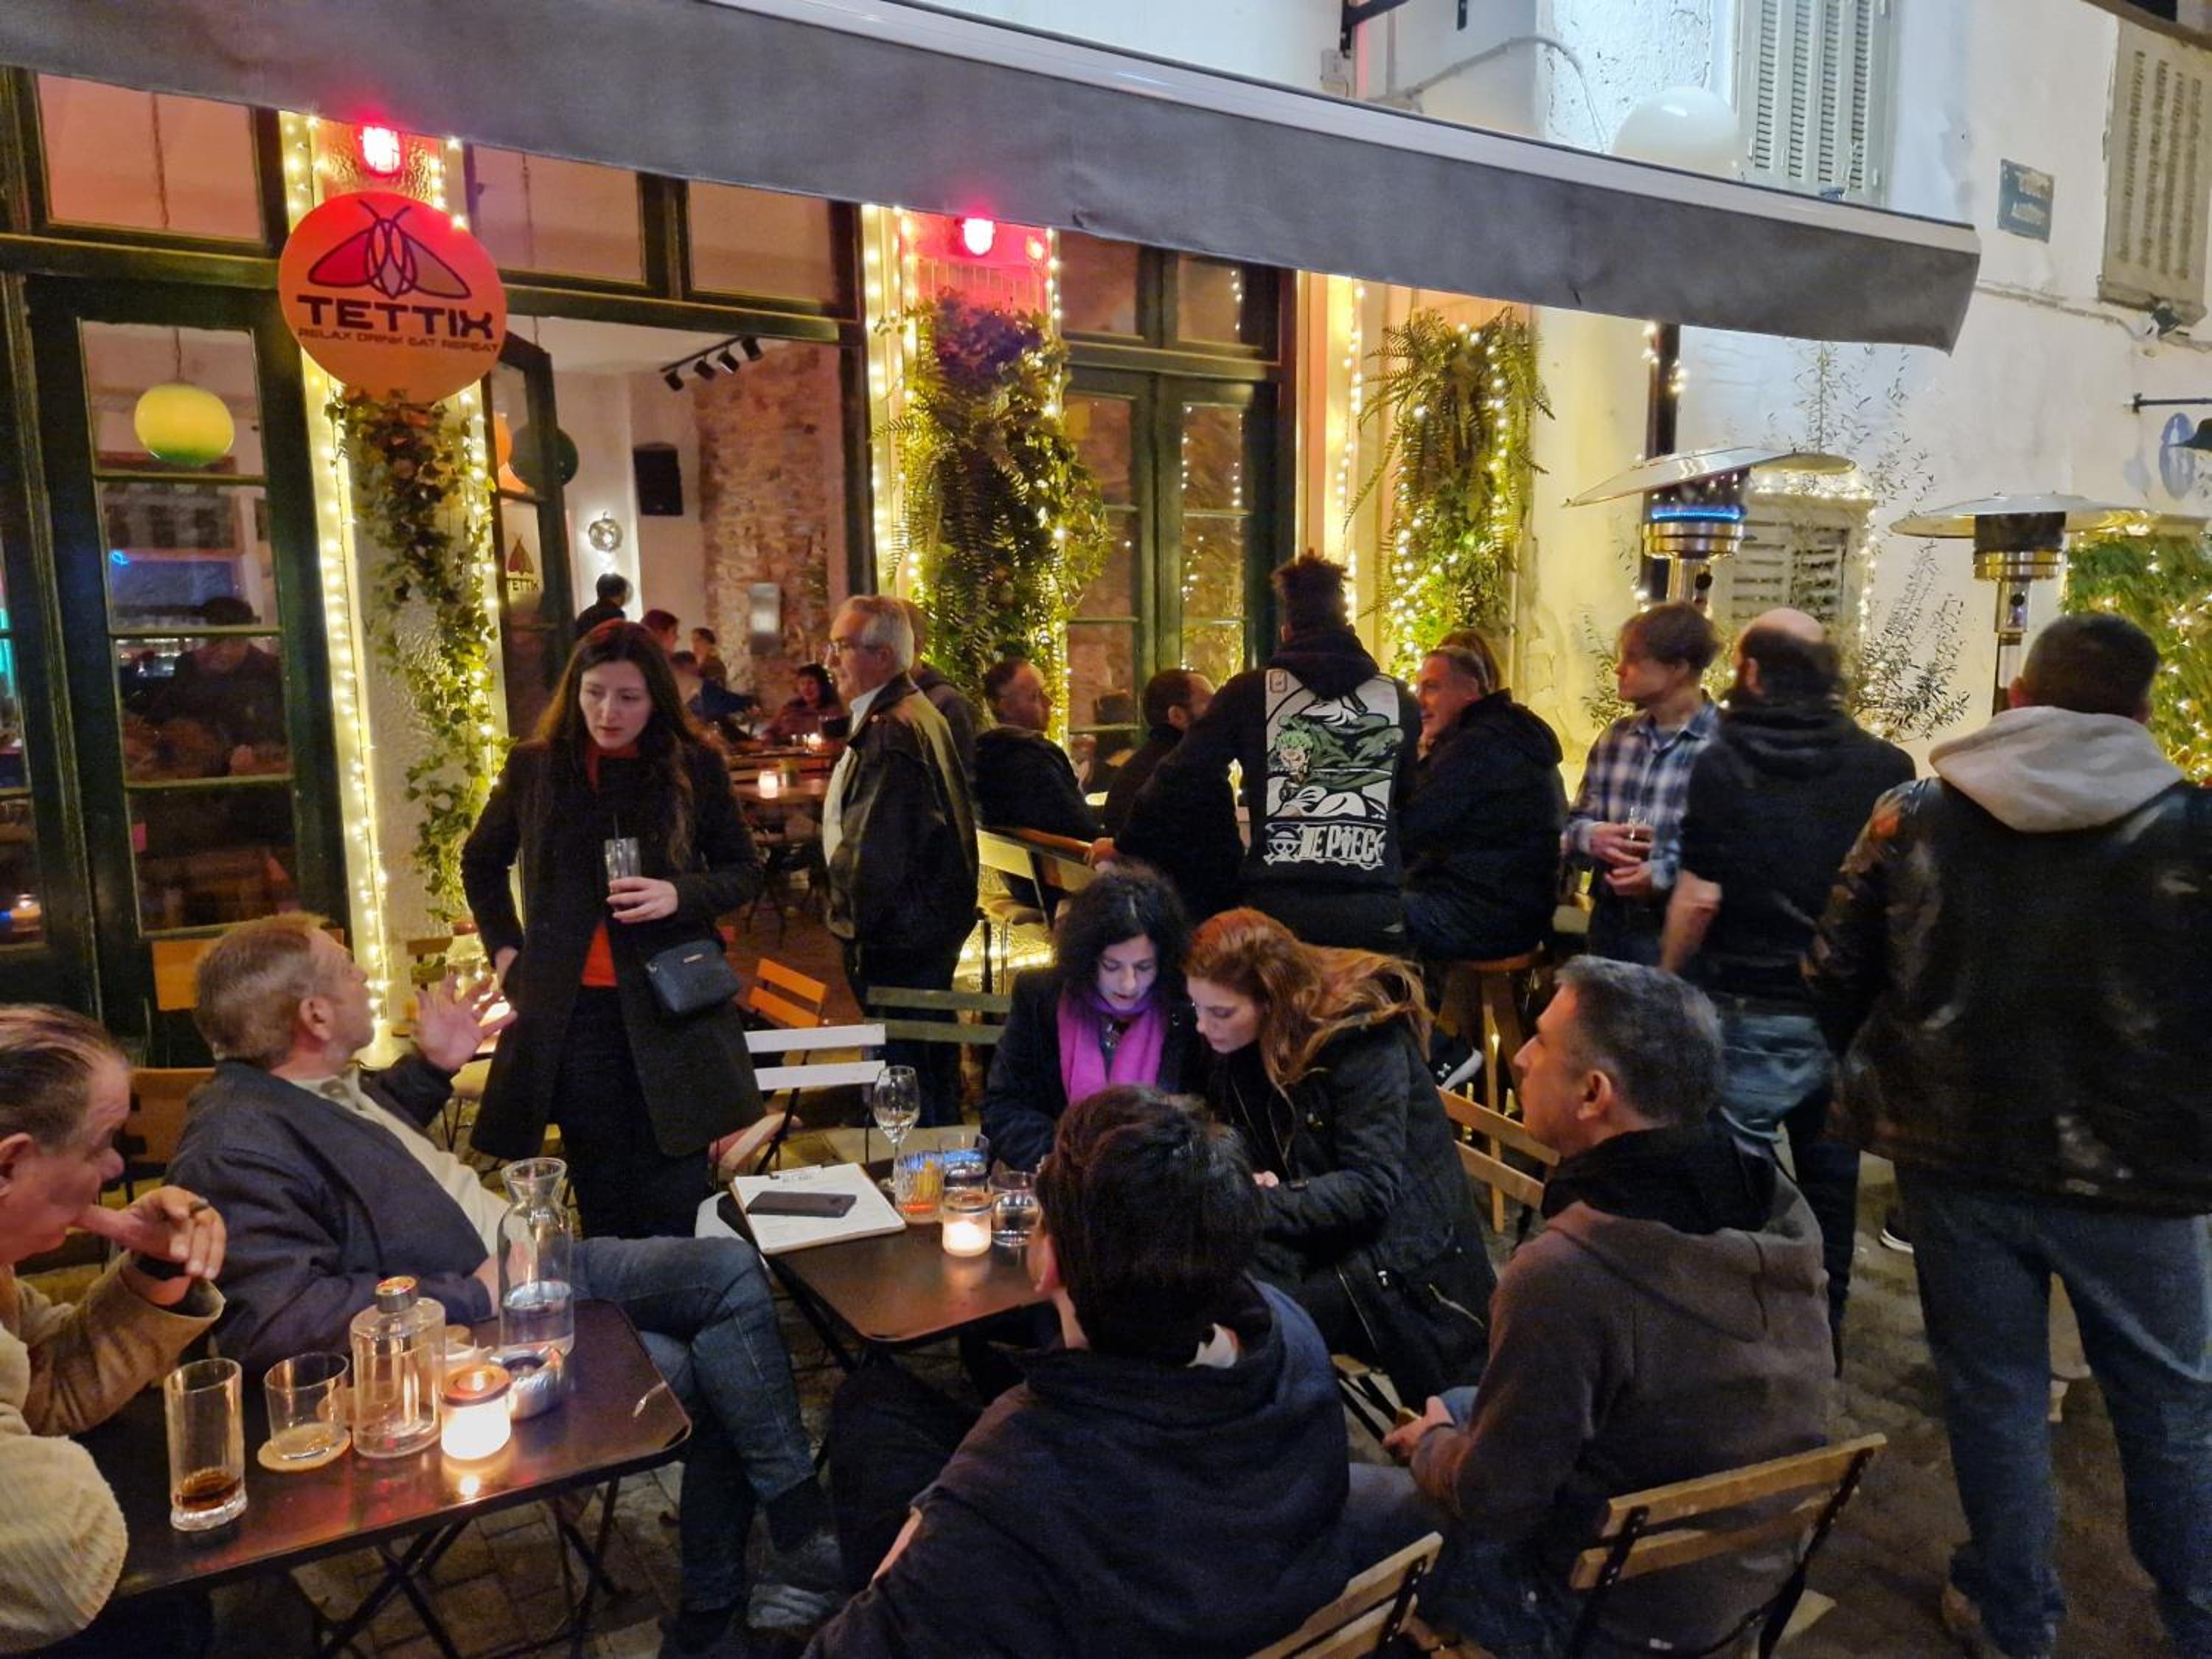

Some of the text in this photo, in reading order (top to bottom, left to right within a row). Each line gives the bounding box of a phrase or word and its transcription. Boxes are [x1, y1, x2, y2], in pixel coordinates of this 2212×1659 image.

[297, 294, 493, 339] TETTIX
[298, 328, 498, 352] RELAX DRINK EAT REPEAT
